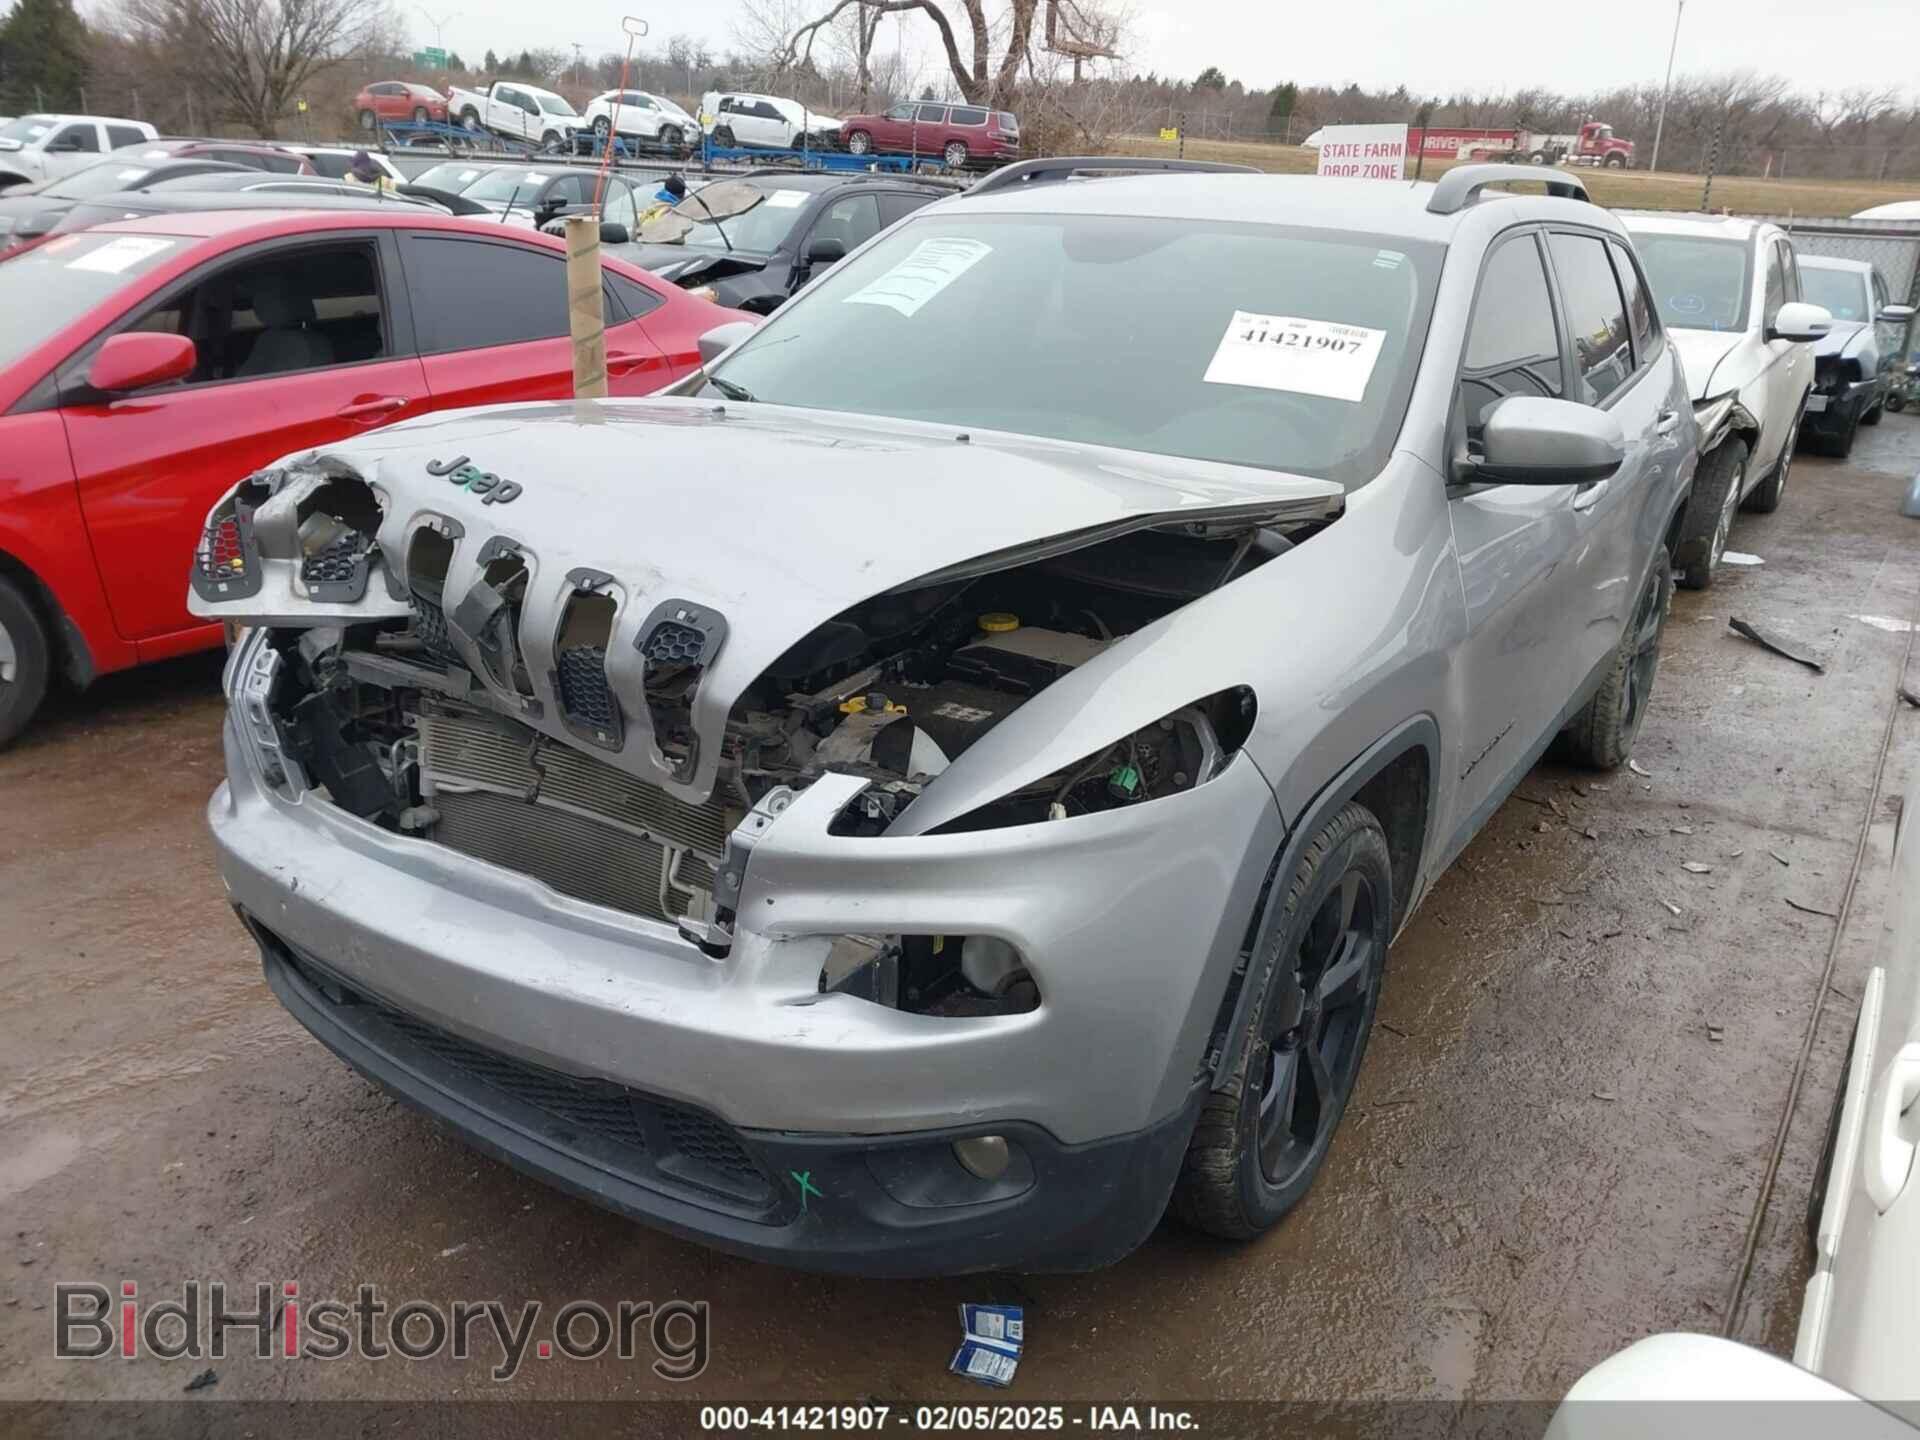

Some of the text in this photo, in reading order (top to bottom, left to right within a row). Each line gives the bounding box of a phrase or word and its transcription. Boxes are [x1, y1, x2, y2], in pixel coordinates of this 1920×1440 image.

[1323, 143, 1402, 158] STATE FARM
[1323, 164, 1398, 179] DROP ZONE
[1240, 329, 1362, 355] 41421907
[425, 455, 523, 506] Jeep
